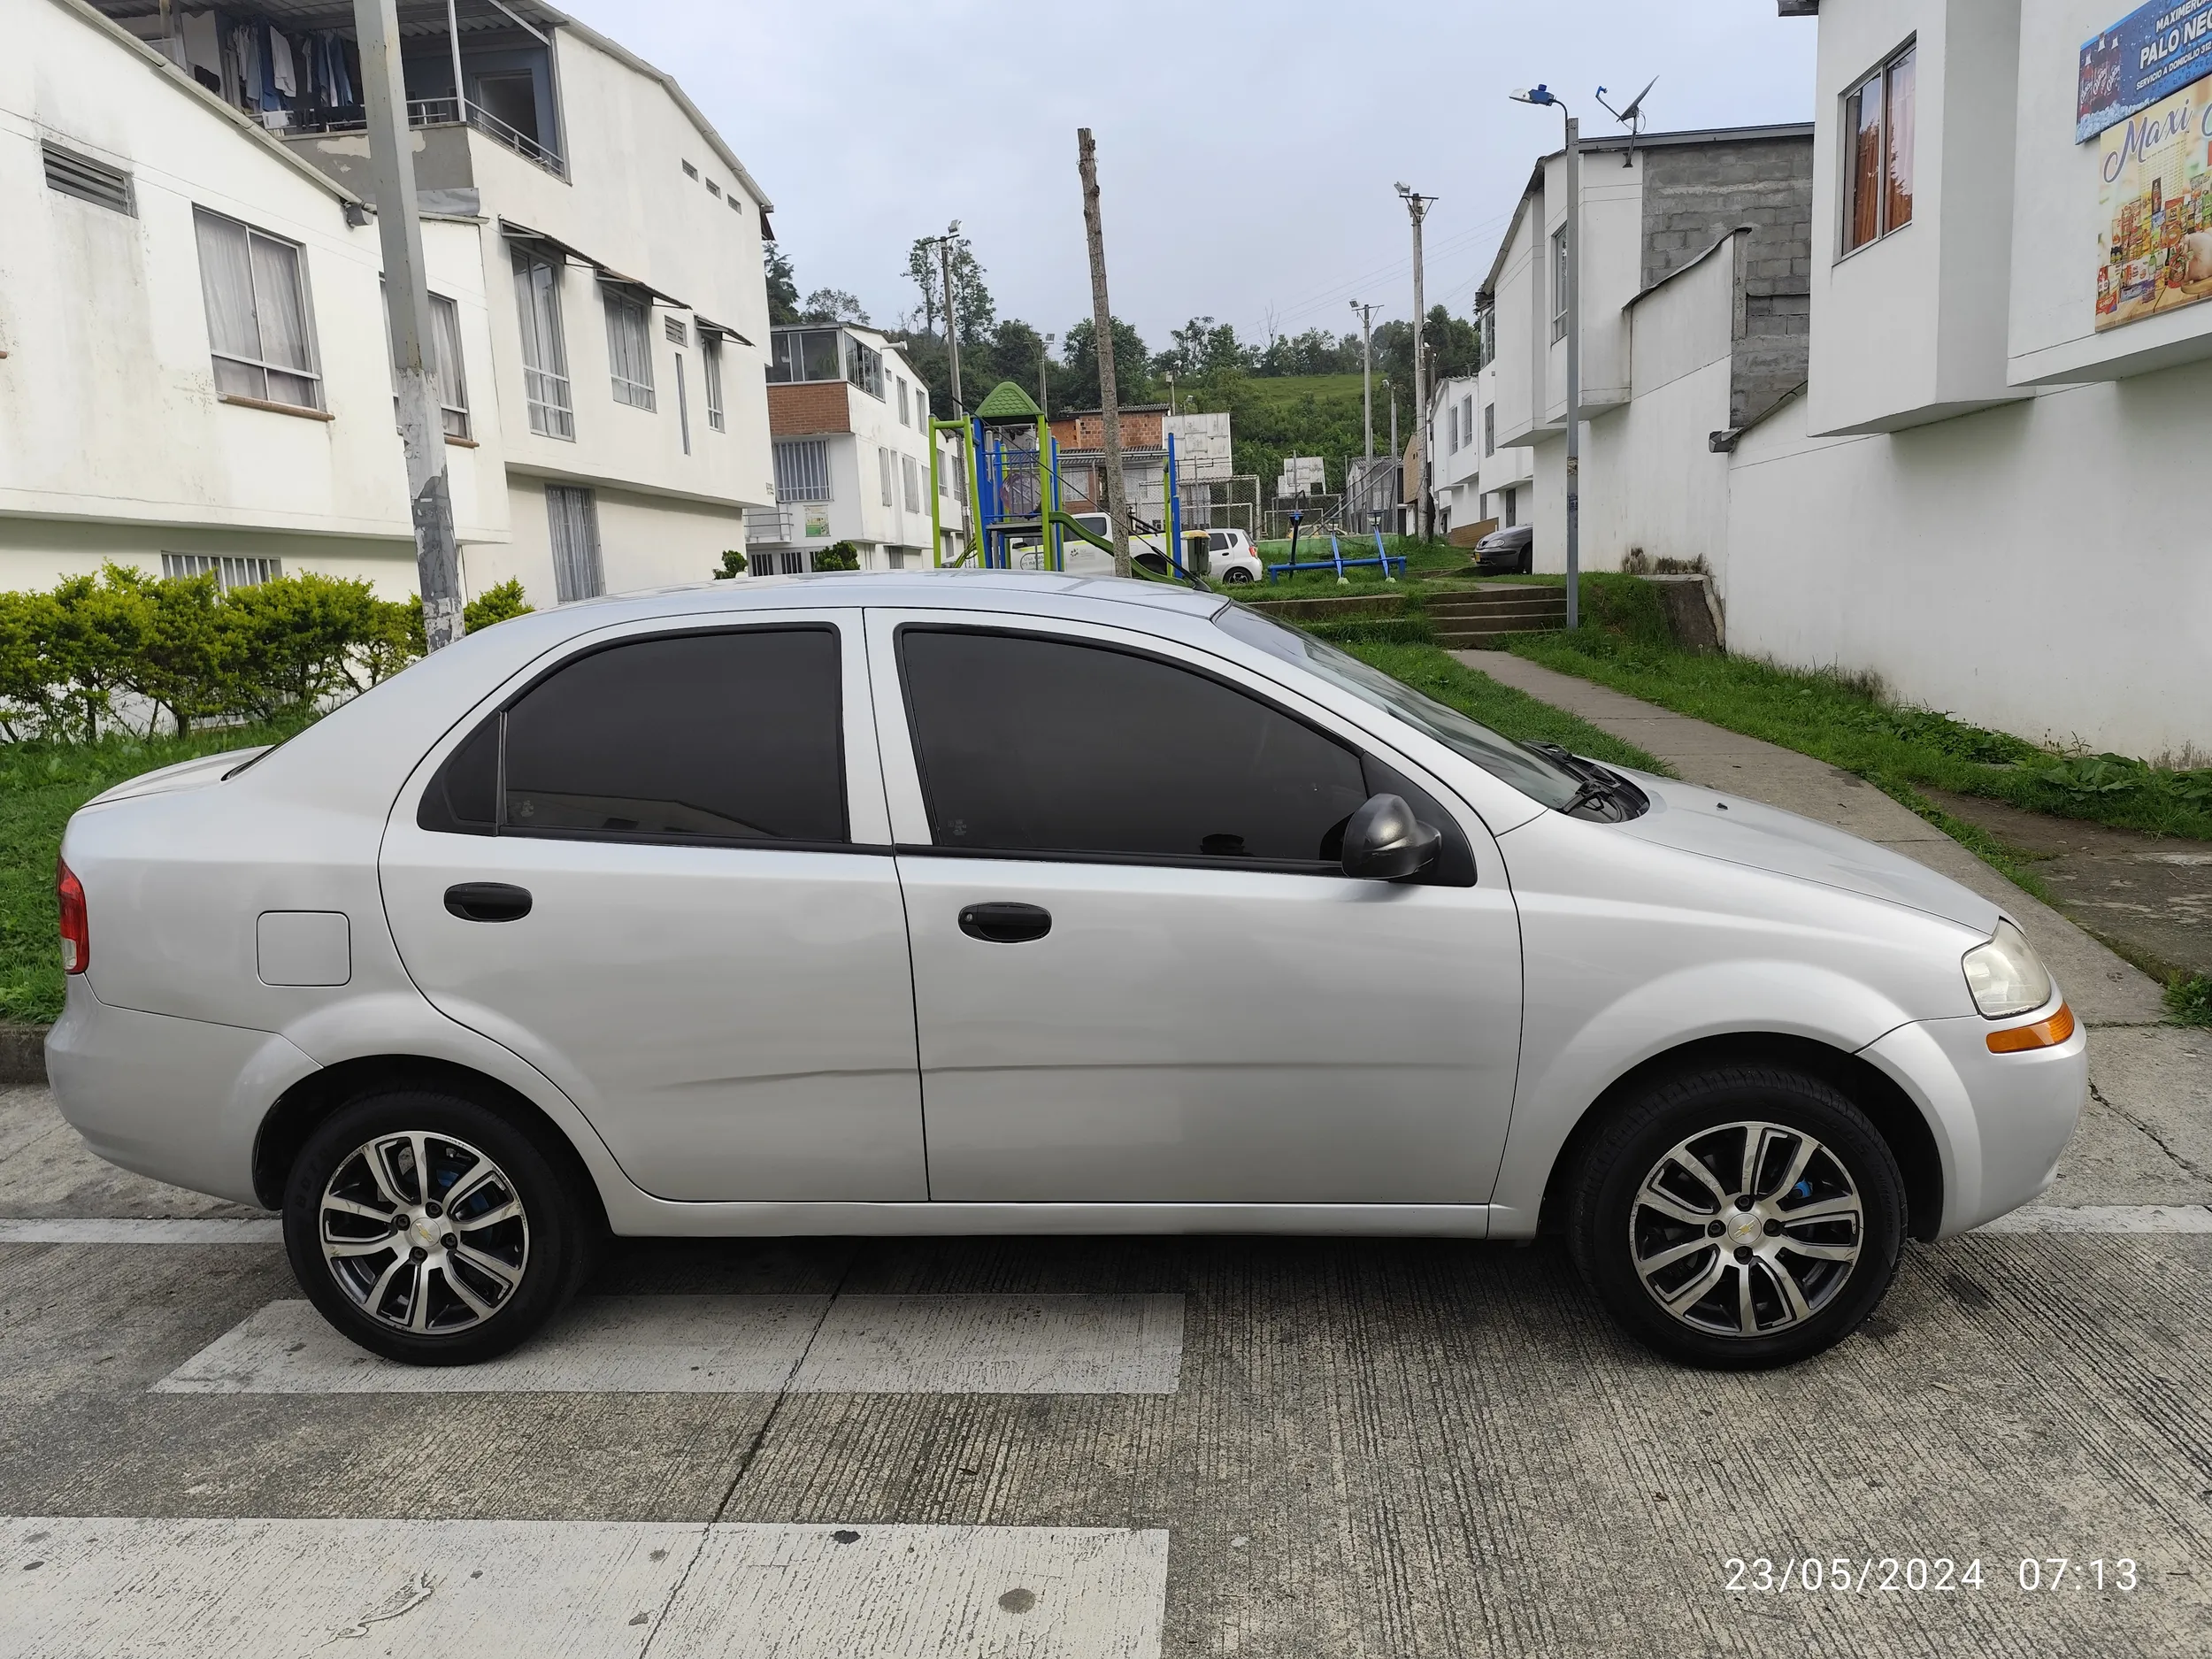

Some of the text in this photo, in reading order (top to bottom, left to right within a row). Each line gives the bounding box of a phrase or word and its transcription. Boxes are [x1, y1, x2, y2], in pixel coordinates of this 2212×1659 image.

[2136, 69, 2162, 90] SERVICIO
[2162, 66, 2168, 76] A
[2168, 48, 2200, 73] DOMICILIO
[2200, 41, 2212, 54] 312
[2139, 28, 2179, 69] PALO
[2103, 99, 2193, 183] Maxi
